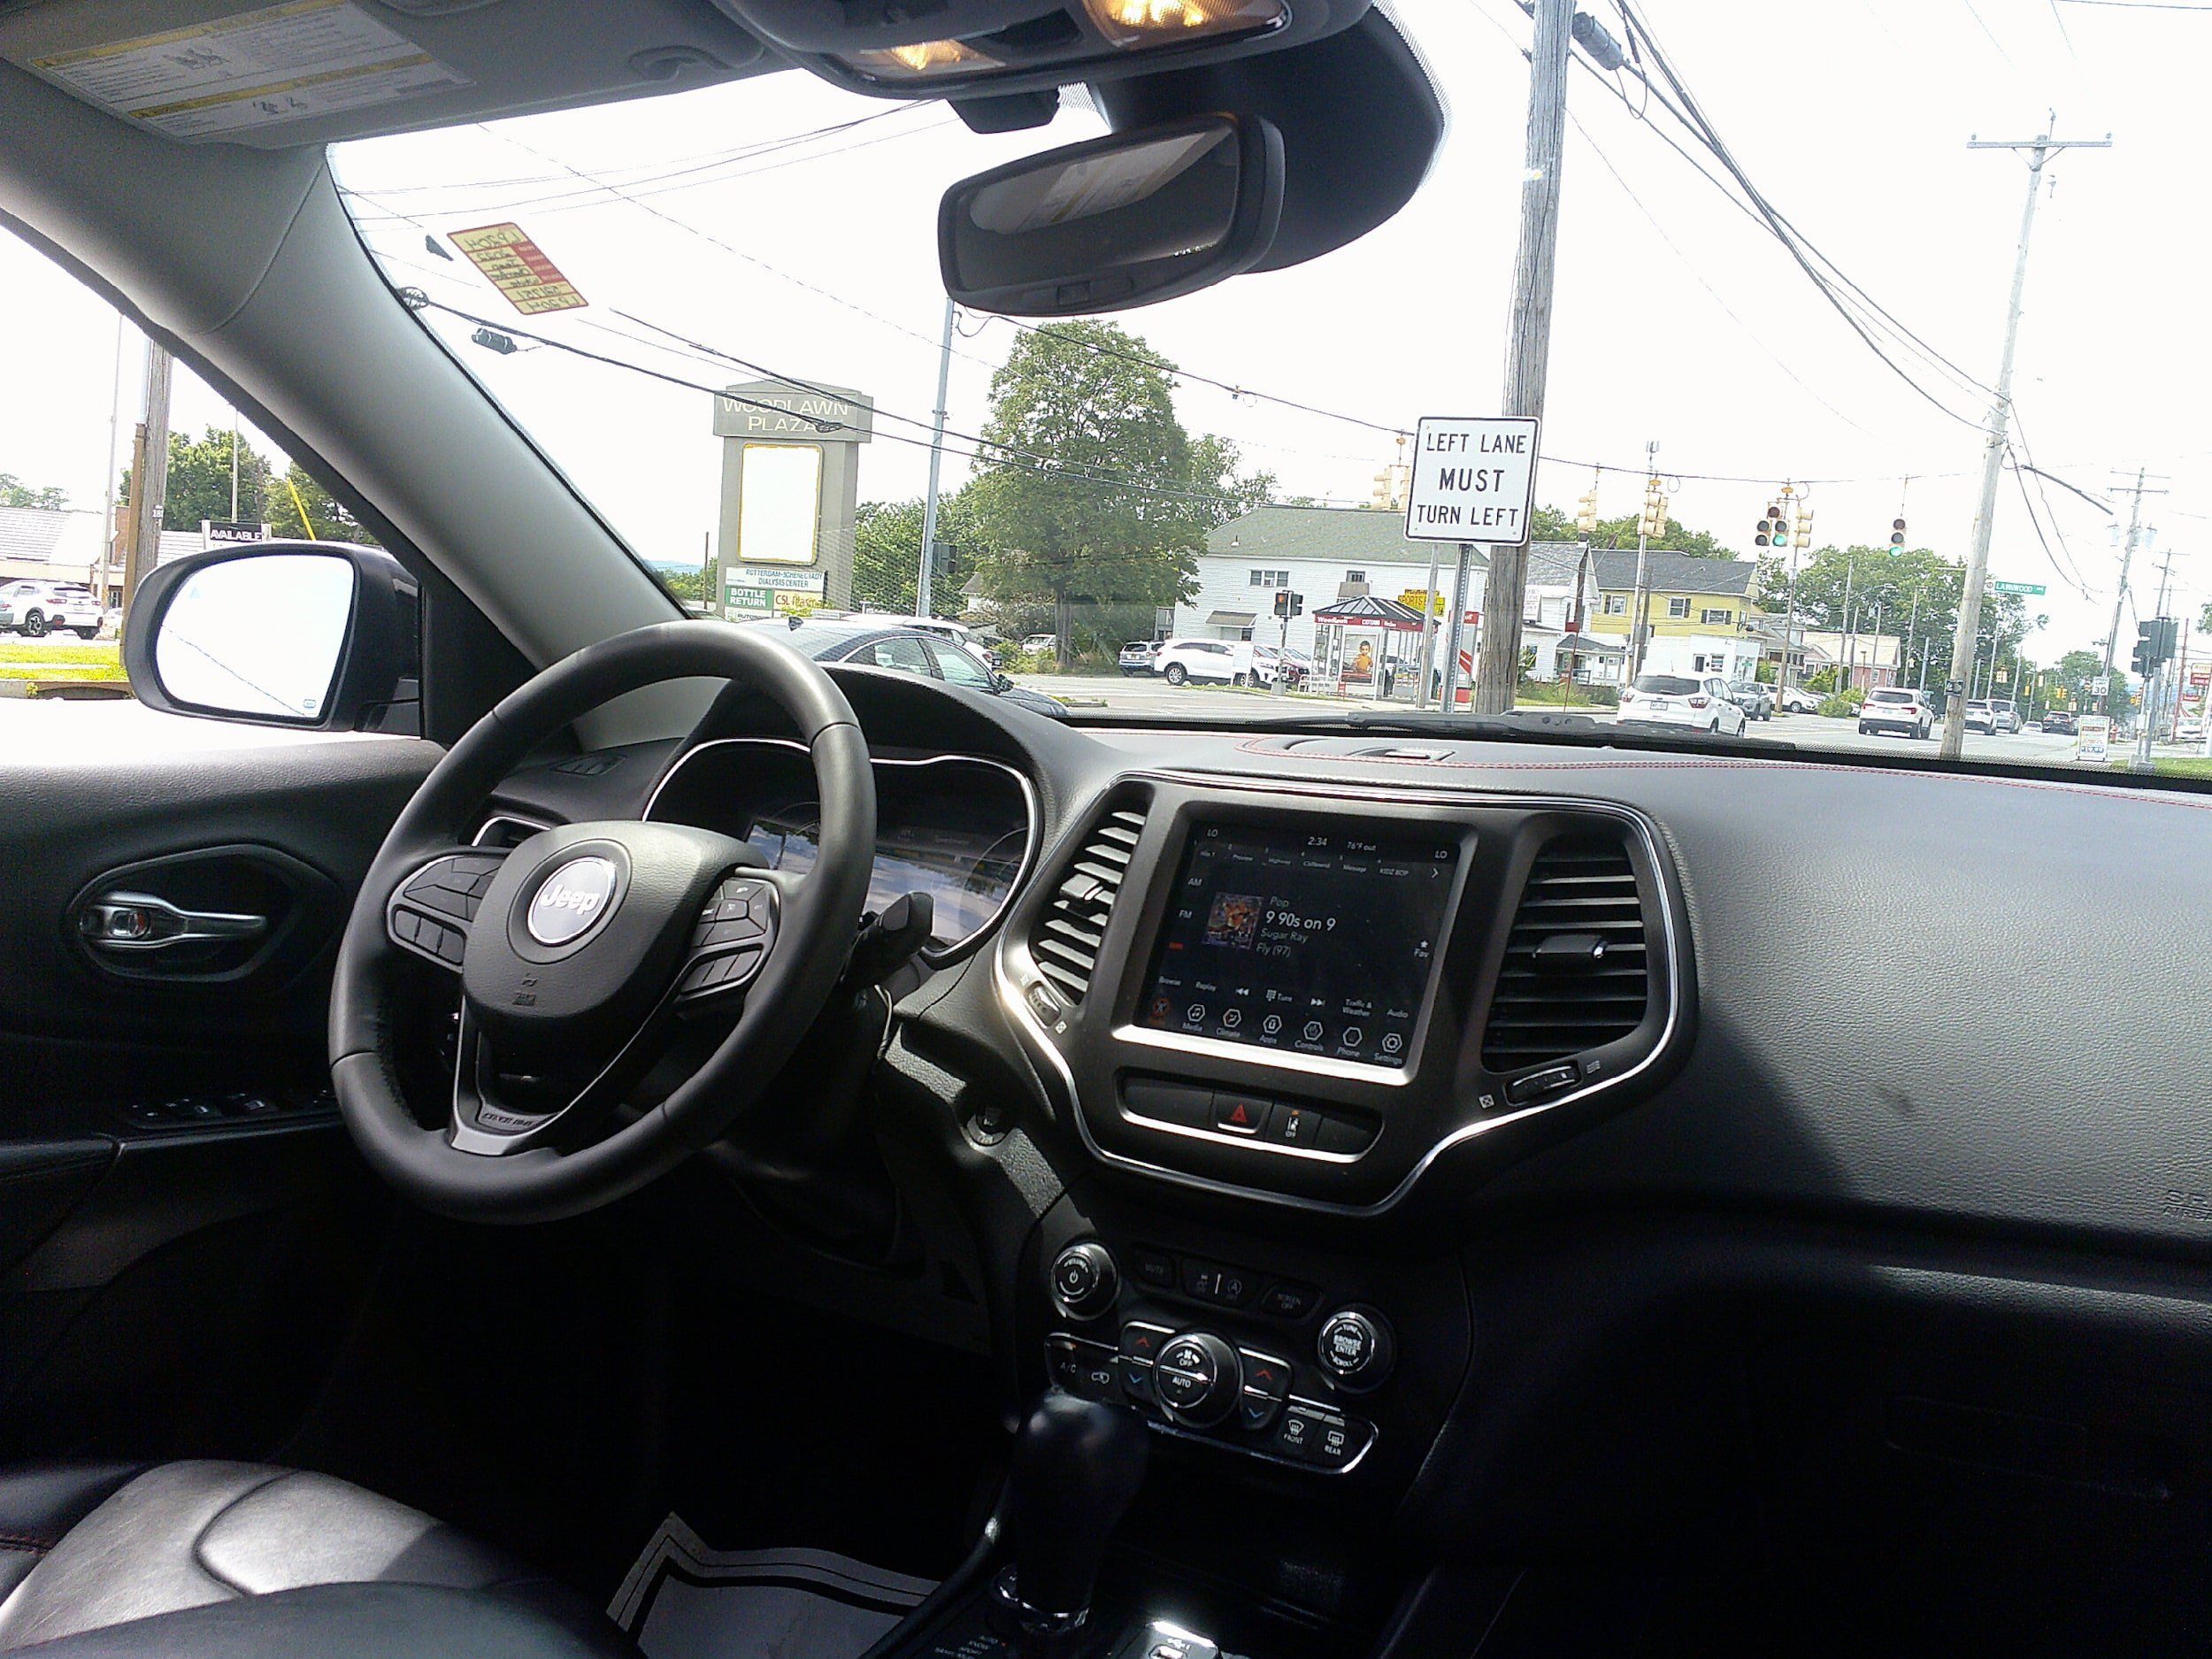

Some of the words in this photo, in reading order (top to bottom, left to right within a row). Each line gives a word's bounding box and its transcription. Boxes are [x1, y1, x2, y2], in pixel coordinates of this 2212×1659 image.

[722, 398, 849, 416] WOODLAWN
[748, 416, 818, 432] PLAZA
[1426, 433, 1470, 452] LEFT
[1480, 434, 1527, 454] LANE
[1439, 467, 1505, 492] MUST
[1417, 504, 1462, 525] TURN
[1470, 506, 1519, 526] LEFT
[211, 529, 262, 541] AVAILABLE
[758, 578, 786, 588] DIALYSIS
[786, 580, 809, 588] CENTER
[731, 588, 766, 599] BOTTLE
[730, 596, 766, 607] RETURN
[775, 595, 790, 605] CSL
[1308, 836, 1327, 846] 2:34
[1434, 850, 1448, 859] LO
[541, 885, 600, 915] Jeep
[1270, 896, 1289, 909] Pop
[1179, 910, 1192, 918] FM
[1266, 910, 1275, 924] 9
[1278, 912, 1301, 926] 90s
[1304, 918, 1322, 930] on
[1326, 918, 1337, 931] 9
[1261, 929, 1288, 942] Sugar
[1290, 932, 1309, 944] Ray
[1256, 942, 1271, 956] Fly
[1272, 943, 1291, 957] (97)
[1414, 949, 1430, 958] Fav
[1278, 993, 1293, 1002] Tune
[1342, 1006, 1371, 1017] Weather
[1386, 1009, 1409, 1018] Audio
[1182, 1022, 1202, 1032] Media
[1217, 1027, 1240, 1038] Climate
[1259, 1034, 1278, 1044] Apps
[1294, 1040, 1324, 1052] Controls
[1337, 1047, 1360, 1057] Phone
[1374, 1052, 1402, 1064] Settings
[1342, 1324, 1358, 1334] TUNE
[1333, 1334, 1362, 1350] BROWSE
[1335, 1344, 1357, 1356] ENTER
[1058, 1361, 1077, 1373] A/C
[1179, 1357, 1194, 1367] OFF
[1332, 1356, 1354, 1367] SCROLL
[1172, 1376, 1192, 1388] AUTO
[1284, 1433, 1303, 1445] FRONT
[1325, 1444, 1341, 1455] REAR
